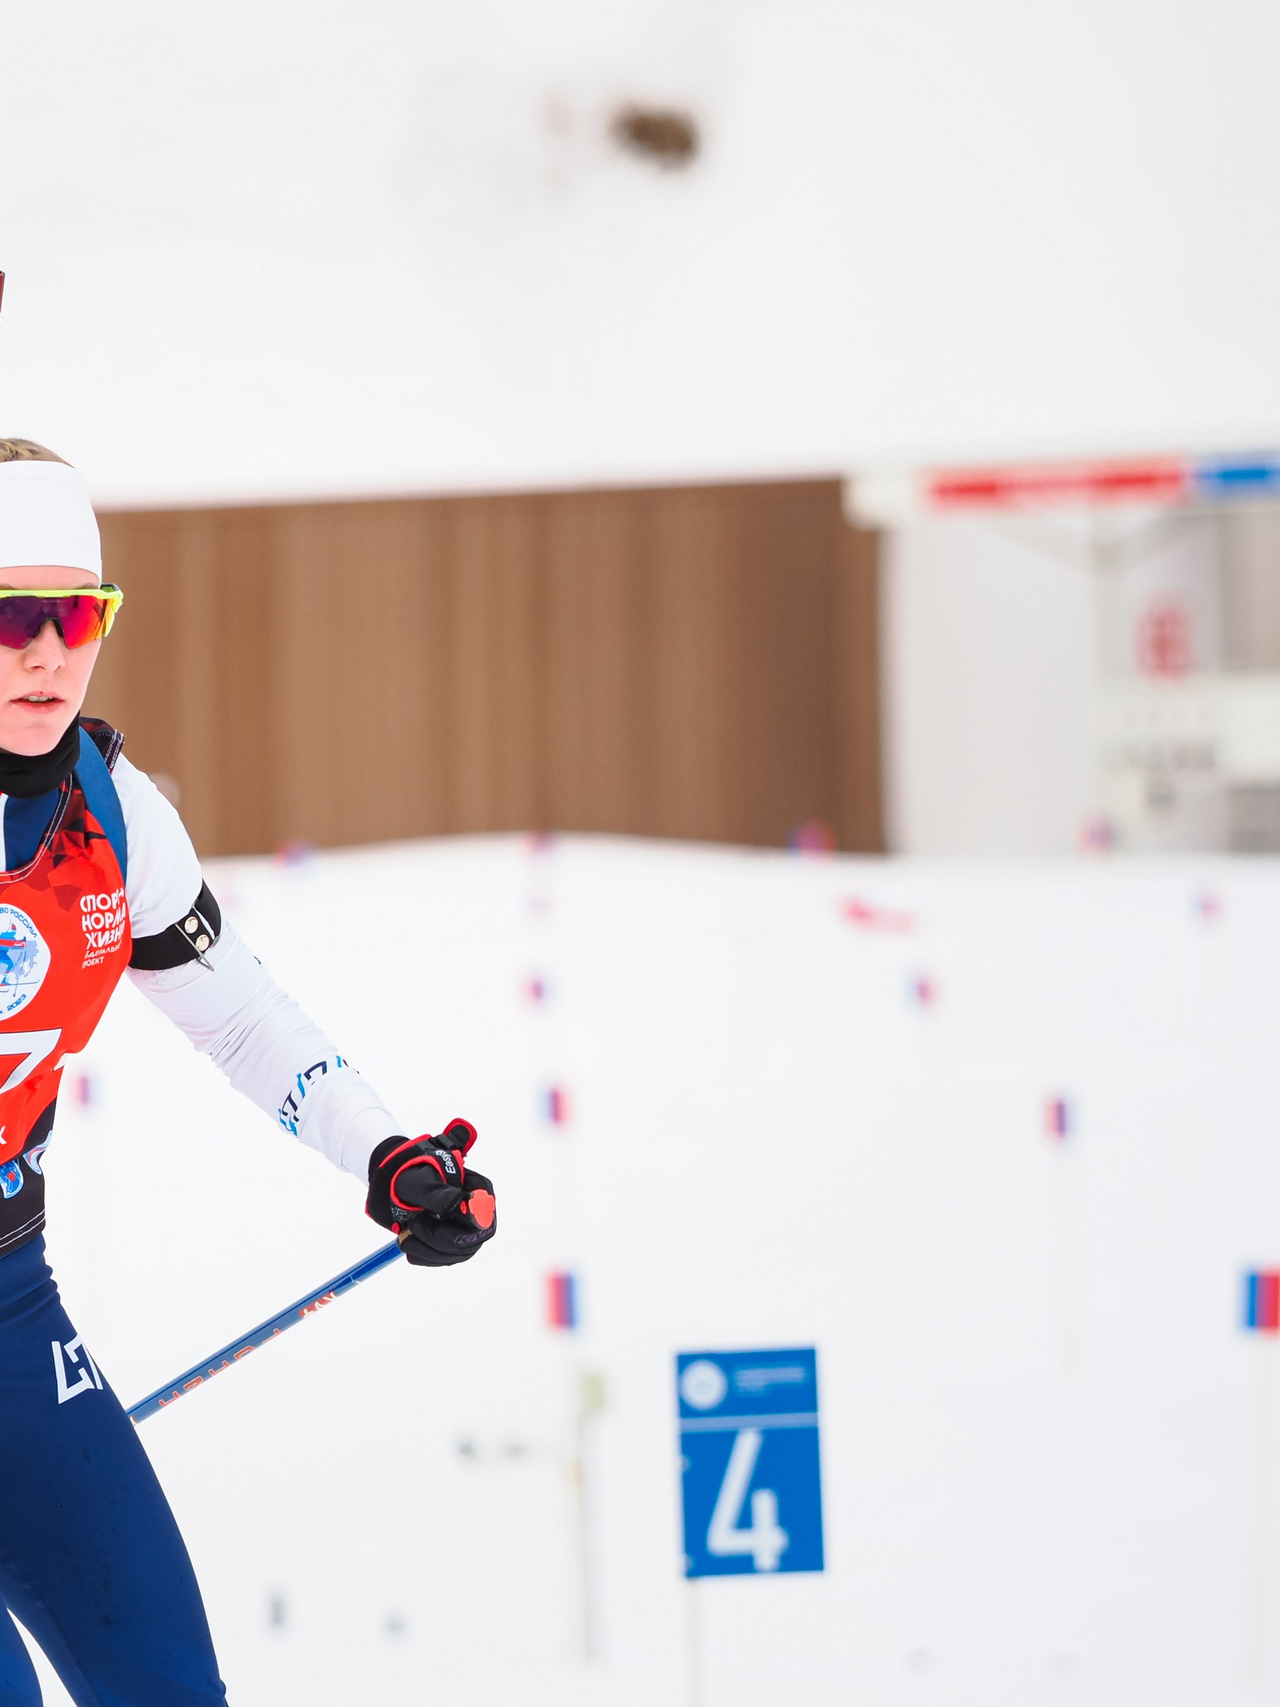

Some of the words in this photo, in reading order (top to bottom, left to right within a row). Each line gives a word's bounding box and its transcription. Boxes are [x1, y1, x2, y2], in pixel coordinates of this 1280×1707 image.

[10, 908, 38, 939] РОССИИ
[6, 993, 27, 1012] 2023
[705, 1426, 790, 1574] 4
